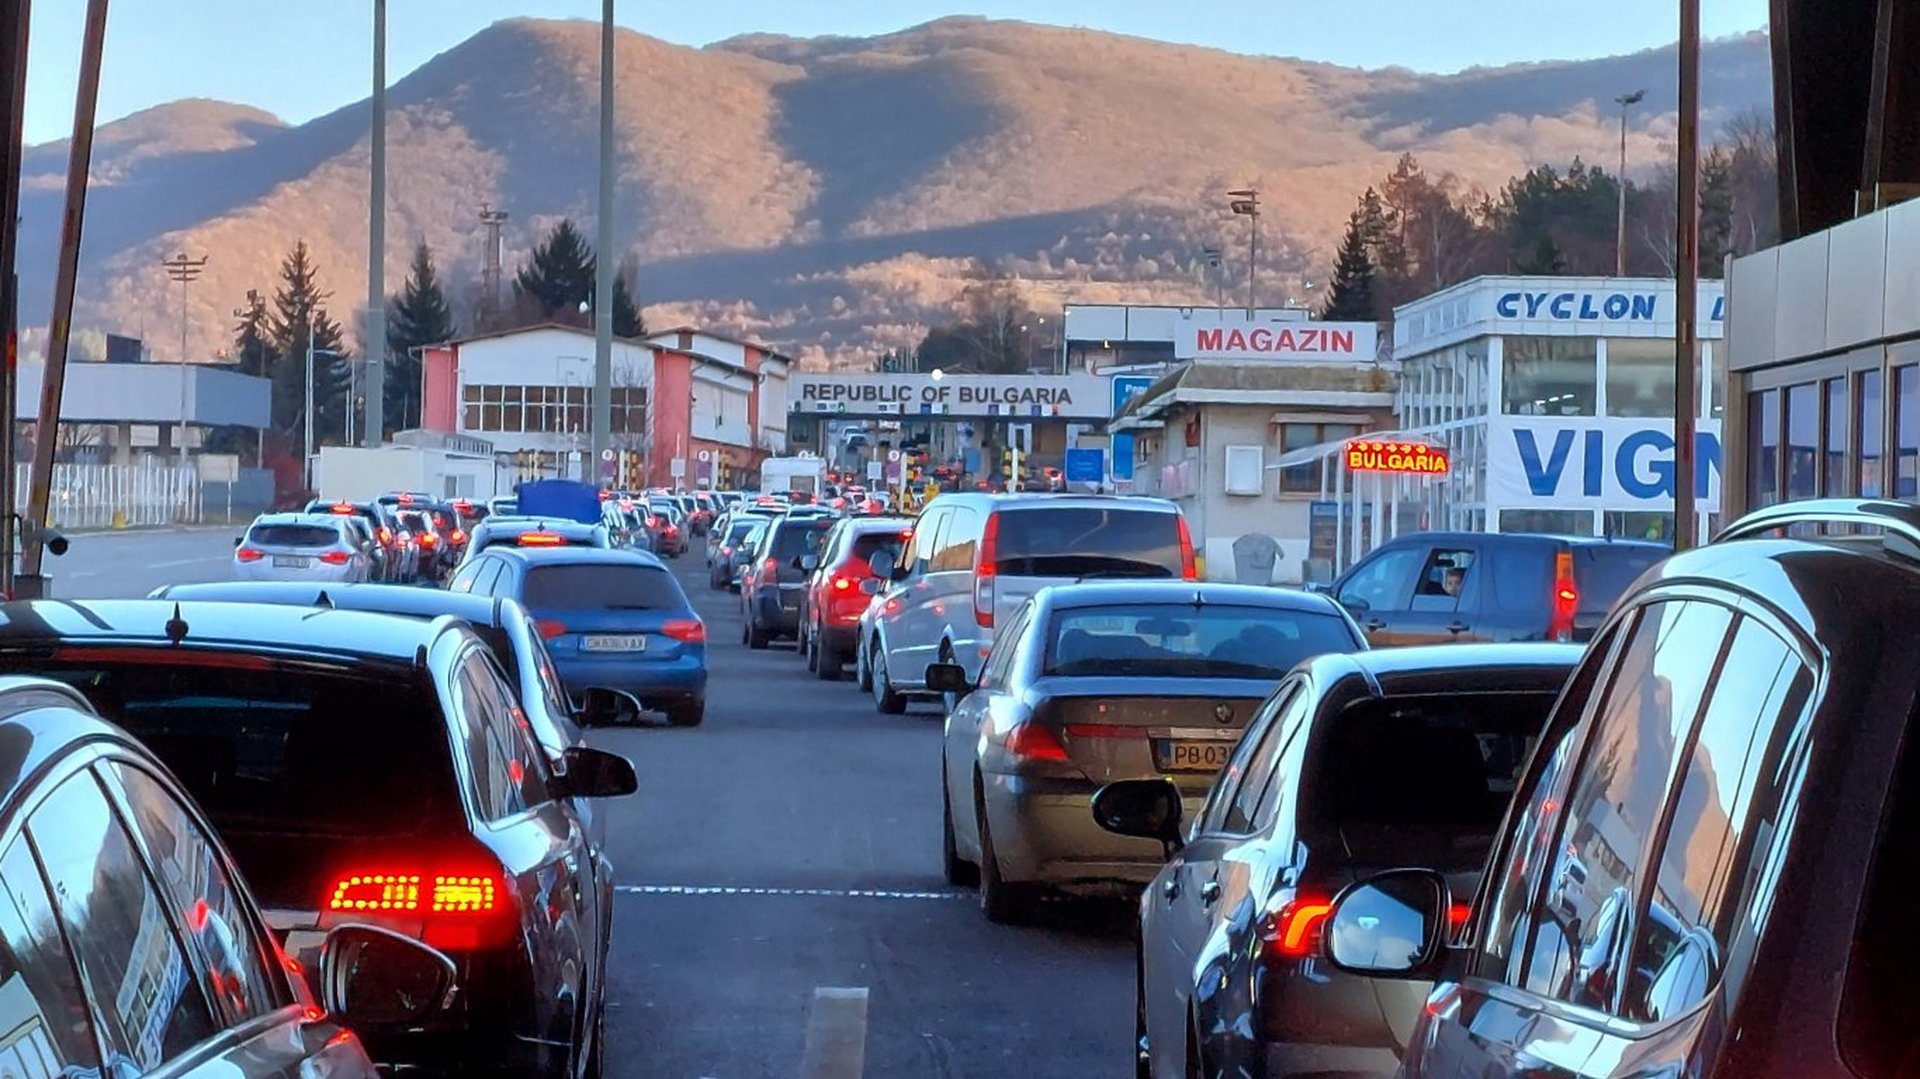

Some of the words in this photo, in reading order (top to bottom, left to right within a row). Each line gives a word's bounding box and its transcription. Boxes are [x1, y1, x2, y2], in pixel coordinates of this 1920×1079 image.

[1496, 293, 1656, 320] CYCLON
[1197, 329, 1354, 353] MAGAZIN
[802, 384, 912, 402] REPUBLIC
[921, 386, 950, 402] OF
[958, 387, 1073, 405] BULGARIA
[1348, 451, 1447, 472] BULGARIA
